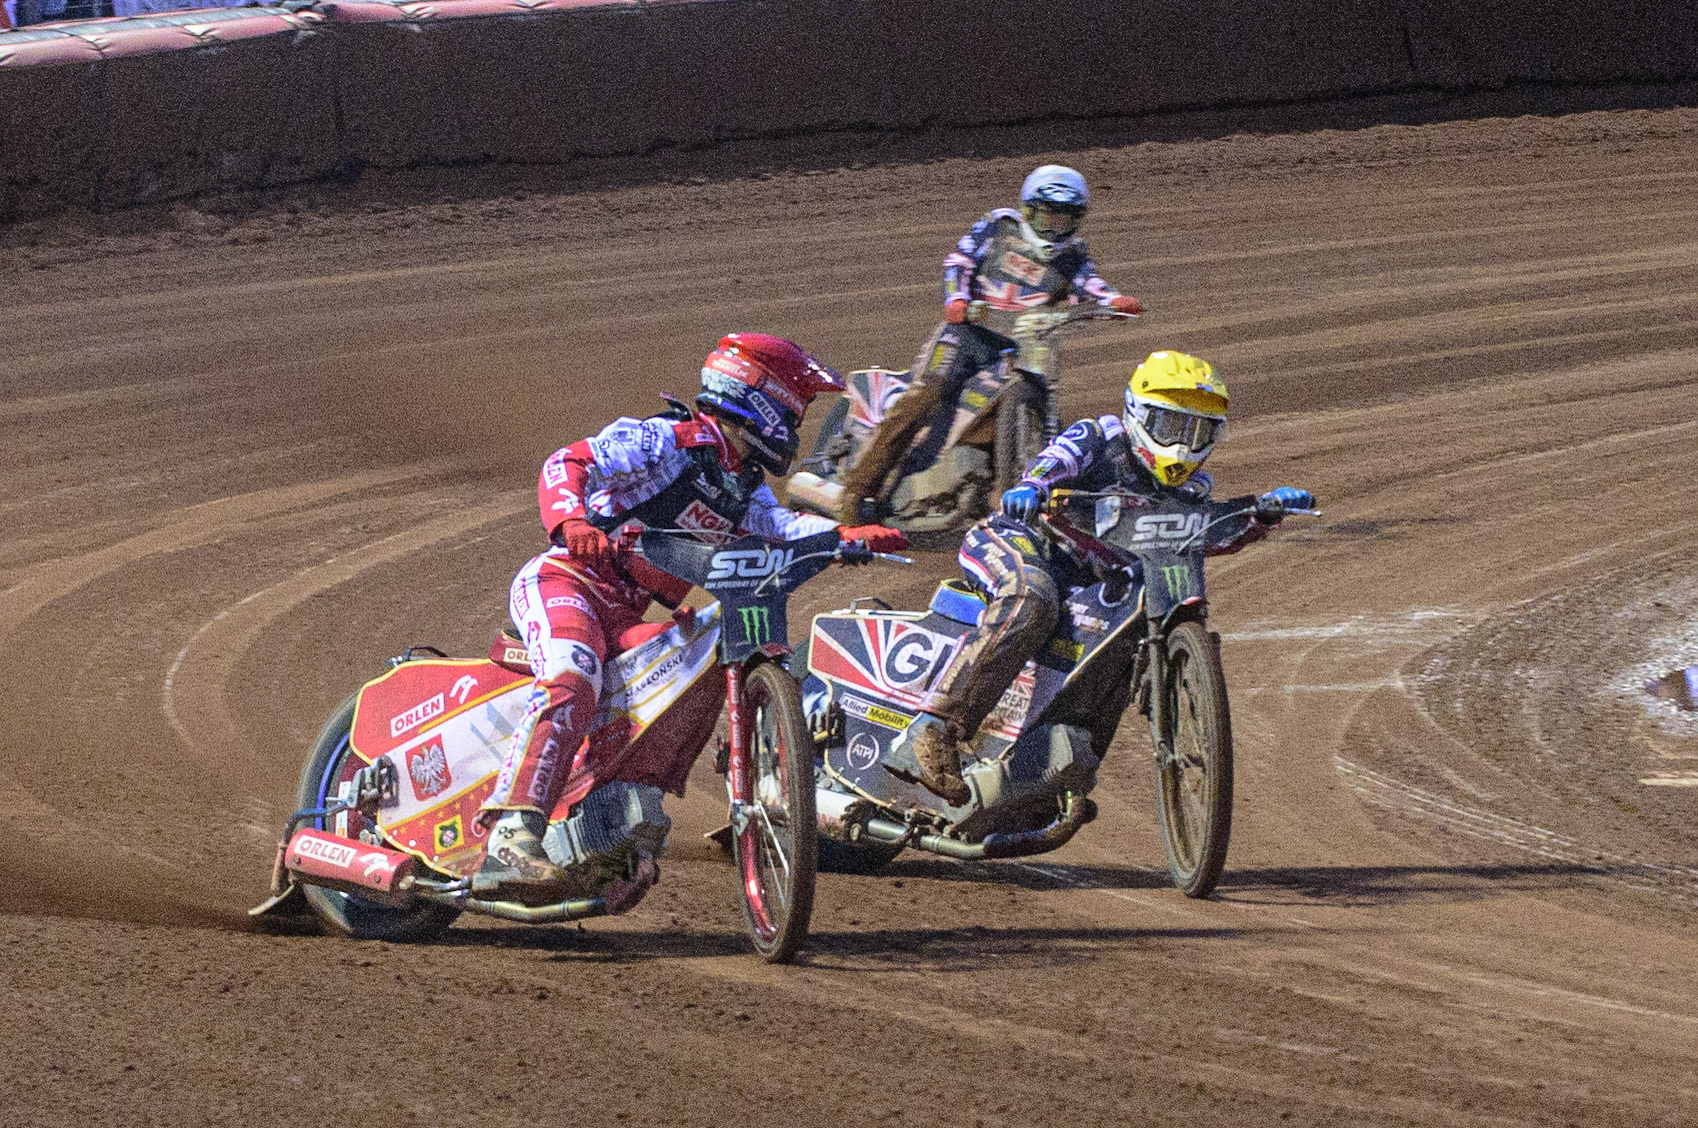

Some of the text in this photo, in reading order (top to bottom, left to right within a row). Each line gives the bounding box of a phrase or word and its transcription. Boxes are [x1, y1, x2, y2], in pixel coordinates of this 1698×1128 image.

[751, 394, 778, 422] ORLEN
[507, 650, 529, 661] ORL
[842, 699, 868, 714] Allied
[1001, 692, 1030, 710] REAT
[394, 697, 441, 732] ORLEN
[851, 743, 874, 760] ATPI
[300, 839, 351, 863] ORLEN
